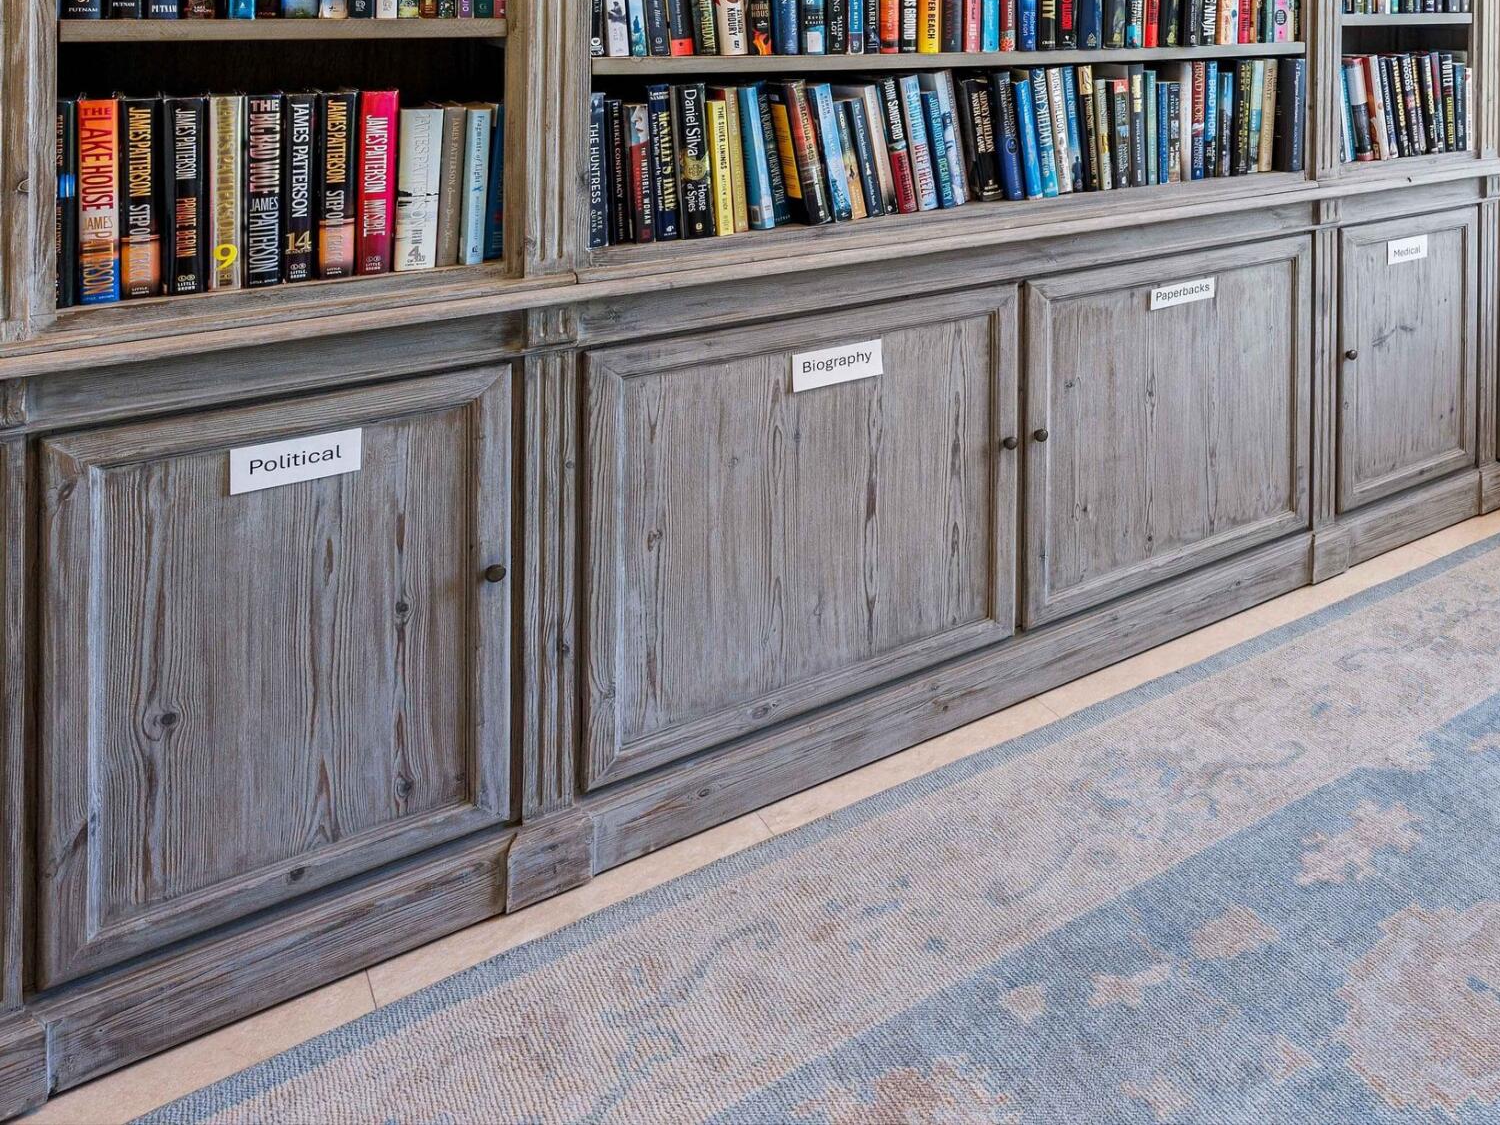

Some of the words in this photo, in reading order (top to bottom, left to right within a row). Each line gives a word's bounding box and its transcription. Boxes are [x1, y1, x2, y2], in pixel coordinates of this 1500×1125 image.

[727, 7, 738, 36] KHOURY
[928, 13, 937, 39] BEACH
[884, 80, 896, 99] JOHN
[1194, 64, 1203, 91] BRAD
[84, 107, 112, 115] THE
[250, 99, 278, 111] THE
[684, 89, 698, 125] Daniel
[887, 100, 903, 139] SANDFORD
[1195, 93, 1203, 121] THOR
[175, 108, 197, 135] JAMES
[250, 112, 280, 132] BIG
[365, 114, 388, 144] JAMES
[590, 123, 598, 144] THE
[80, 116, 113, 163] LAKE
[250, 135, 280, 159] BAD
[687, 127, 700, 157] Silva
[175, 137, 197, 180] PATTERSON
[365, 145, 387, 193] PATTERSON
[81, 165, 113, 211] HOUSE
[250, 161, 279, 193] WOLF
[591, 147, 600, 203] HUNTRESS
[642, 159, 650, 194] INVISIBLE
[176, 197, 196, 228] PRIVATE
[688, 190, 697, 212] Spies
[364, 198, 386, 237] INVISIBLE
[176, 230, 196, 257] BERLIN
[249, 211, 279, 272] PATTERSON
[82, 232, 113, 295] PATTERSON
[1156, 283, 1210, 301] Paperbacks
[802, 351, 872, 373] Biography
[249, 444, 341, 475] Political
